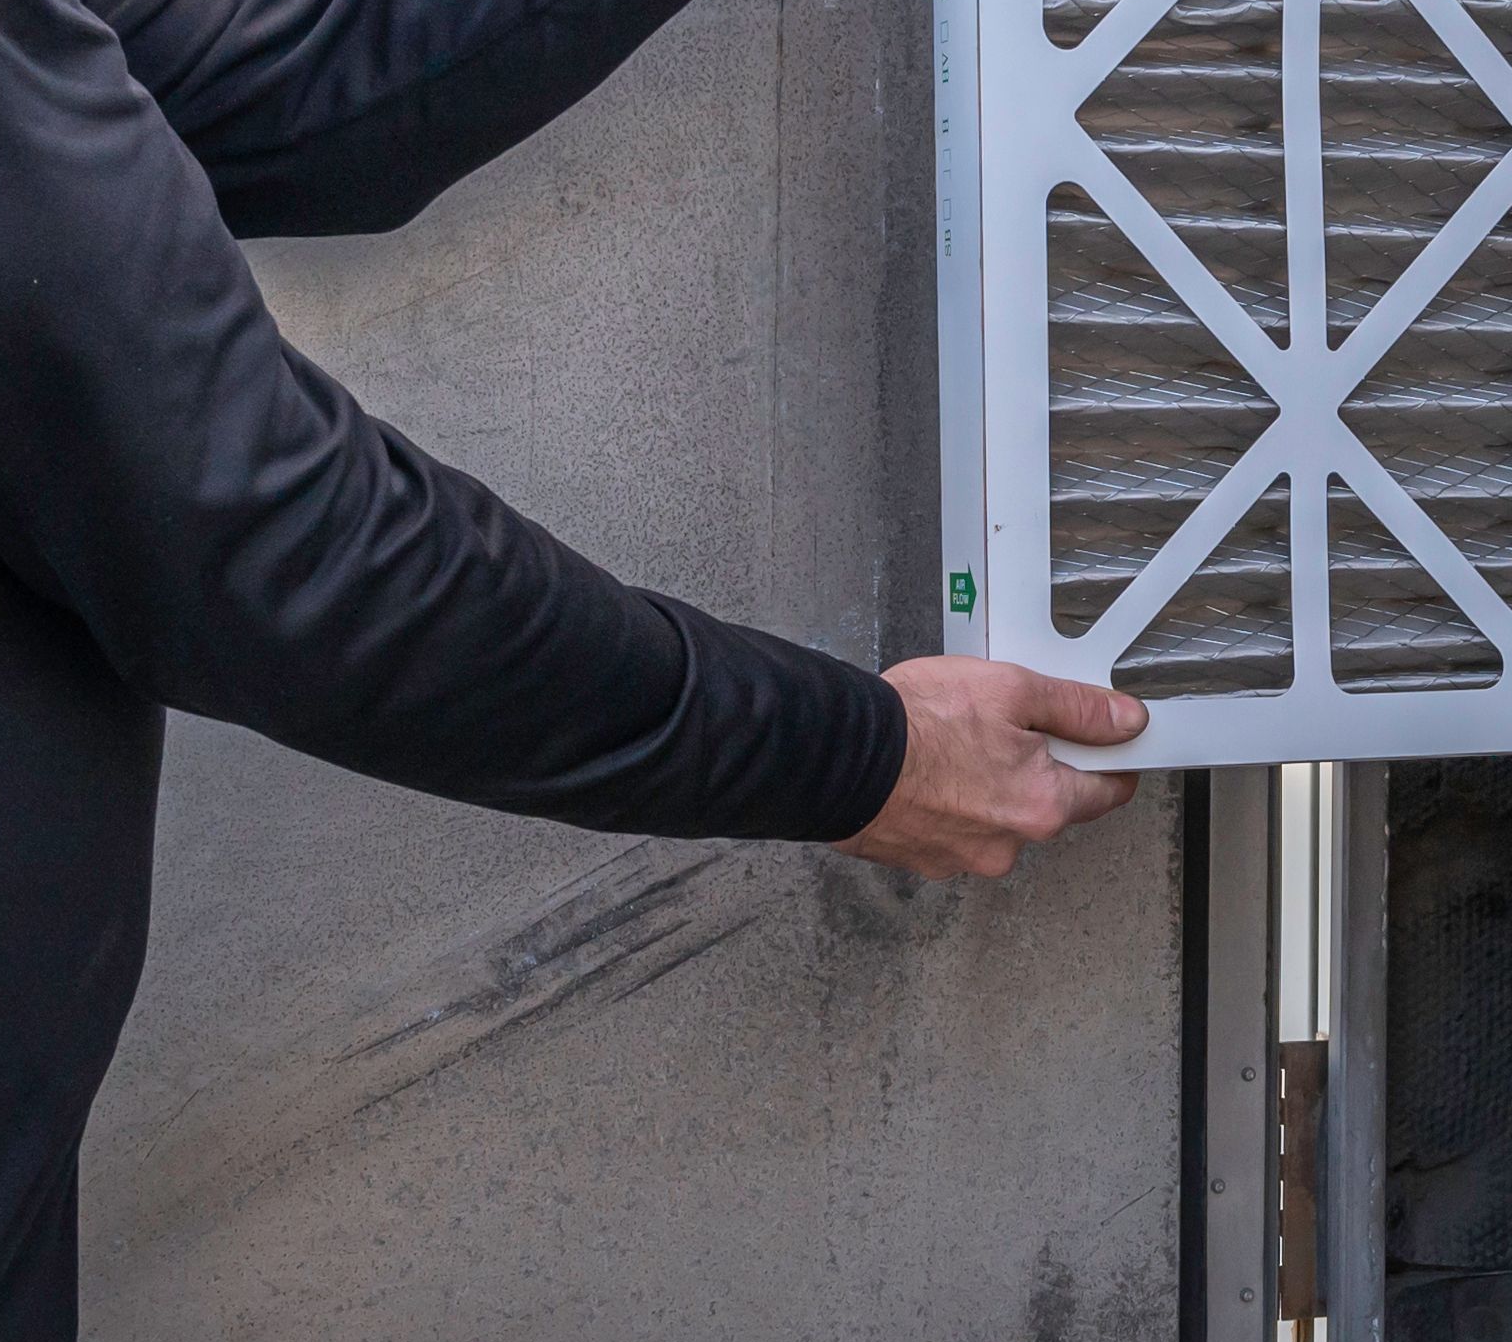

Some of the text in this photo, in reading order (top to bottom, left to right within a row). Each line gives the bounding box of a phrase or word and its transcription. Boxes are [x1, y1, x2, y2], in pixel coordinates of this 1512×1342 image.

[942, 53, 949, 84] HV
[944, 229, 952, 257] SB
[956, 579, 966, 591] AIR
[952, 593, 969, 605] FLOW
